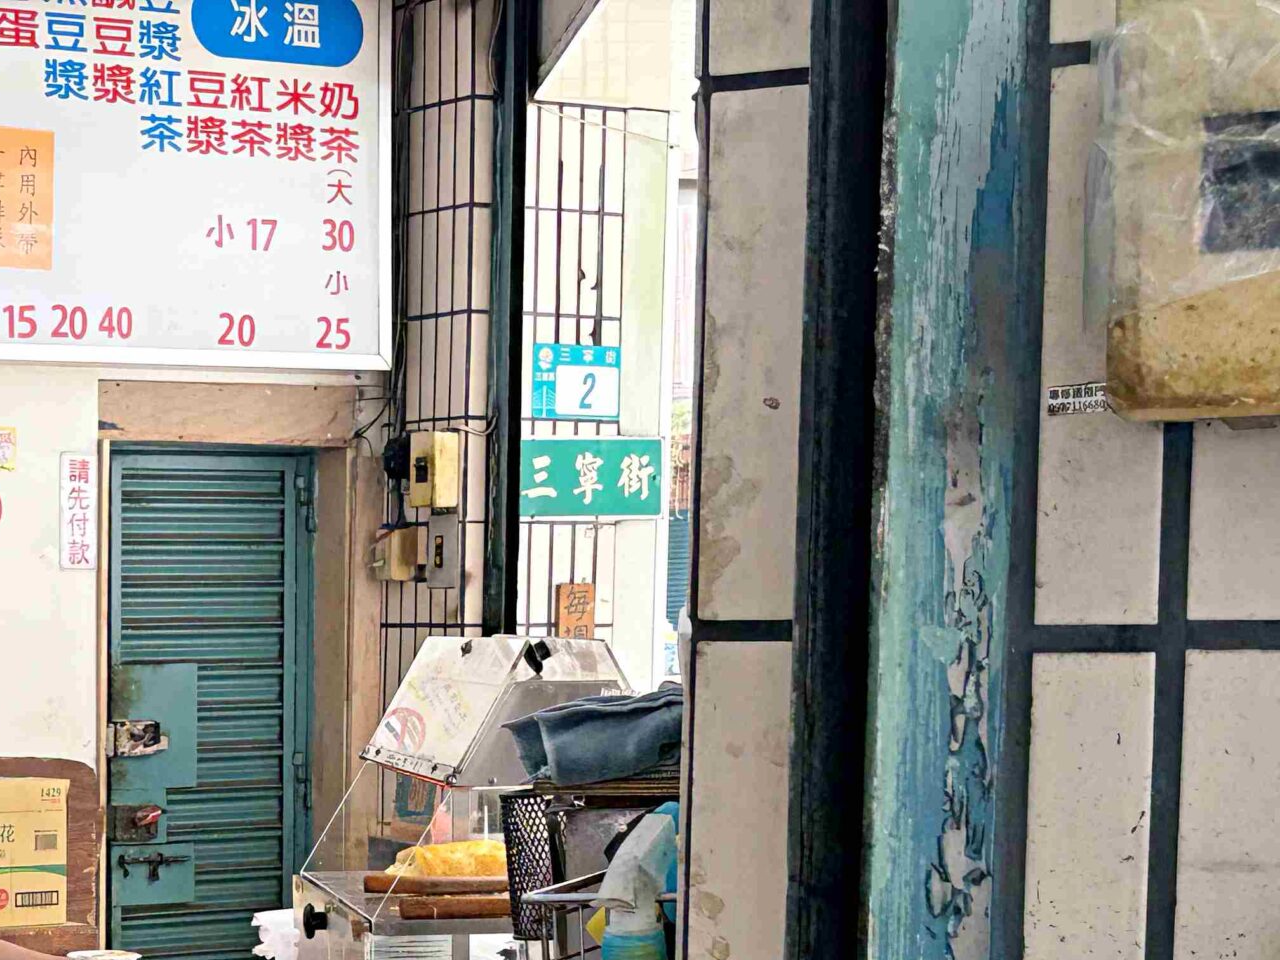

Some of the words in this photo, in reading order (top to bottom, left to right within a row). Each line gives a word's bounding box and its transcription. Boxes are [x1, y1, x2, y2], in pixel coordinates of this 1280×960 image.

[44, 0, 89, 101] 豆漿
[92, 0, 136, 105] 豆漿
[187, 70, 228, 155] 豆漿
[231, 73, 272, 157] 紅茶
[276, 79, 317, 161] 米漿
[319, 82, 360, 163] 奶茶
[15, 145, 39, 255] 內用外帶
[206, 214, 234, 248] 小
[246, 218, 278, 251] 17
[322, 218, 355, 252] 30
[325, 271, 349, 296] 小
[3, 305, 37, 339] 15
[51, 305, 88, 340] 20
[99, 306, 133, 340] 40
[218, 312, 256, 347] 20
[316, 316, 351, 350] 25
[578, 372, 596, 410] 2
[521, 452, 655, 505] 三寧街
[68, 459, 90, 566] 請先付款
